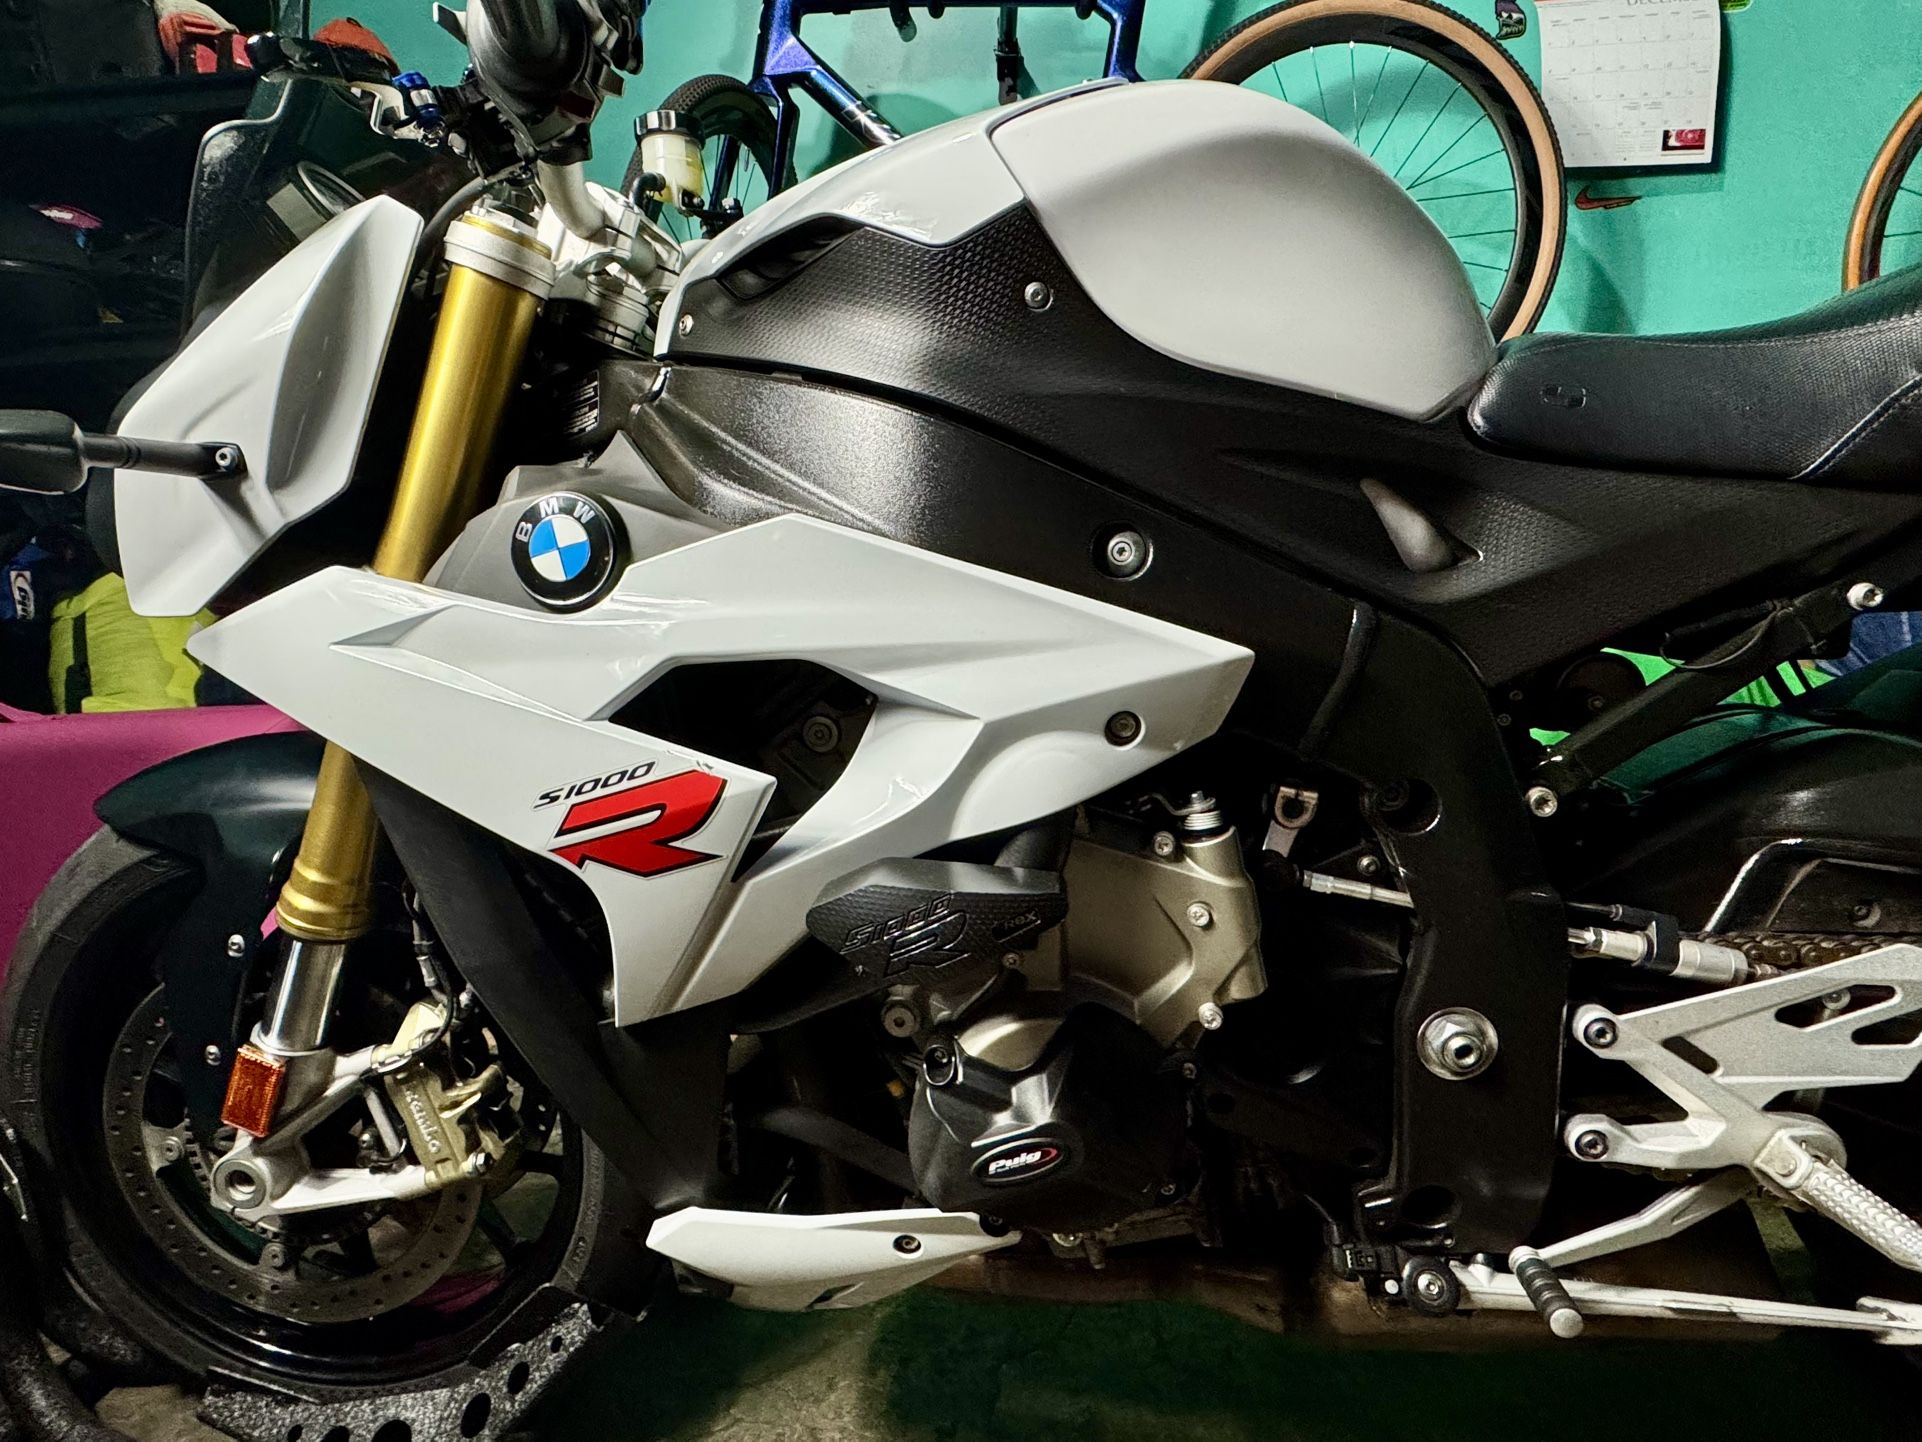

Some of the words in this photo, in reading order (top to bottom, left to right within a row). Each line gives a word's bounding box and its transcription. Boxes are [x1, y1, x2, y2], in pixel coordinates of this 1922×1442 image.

[515, 497, 596, 542] BMW
[533, 761, 656, 809] S1000
[548, 769, 728, 877] R
[988, 1150, 1042, 1172] Puig
